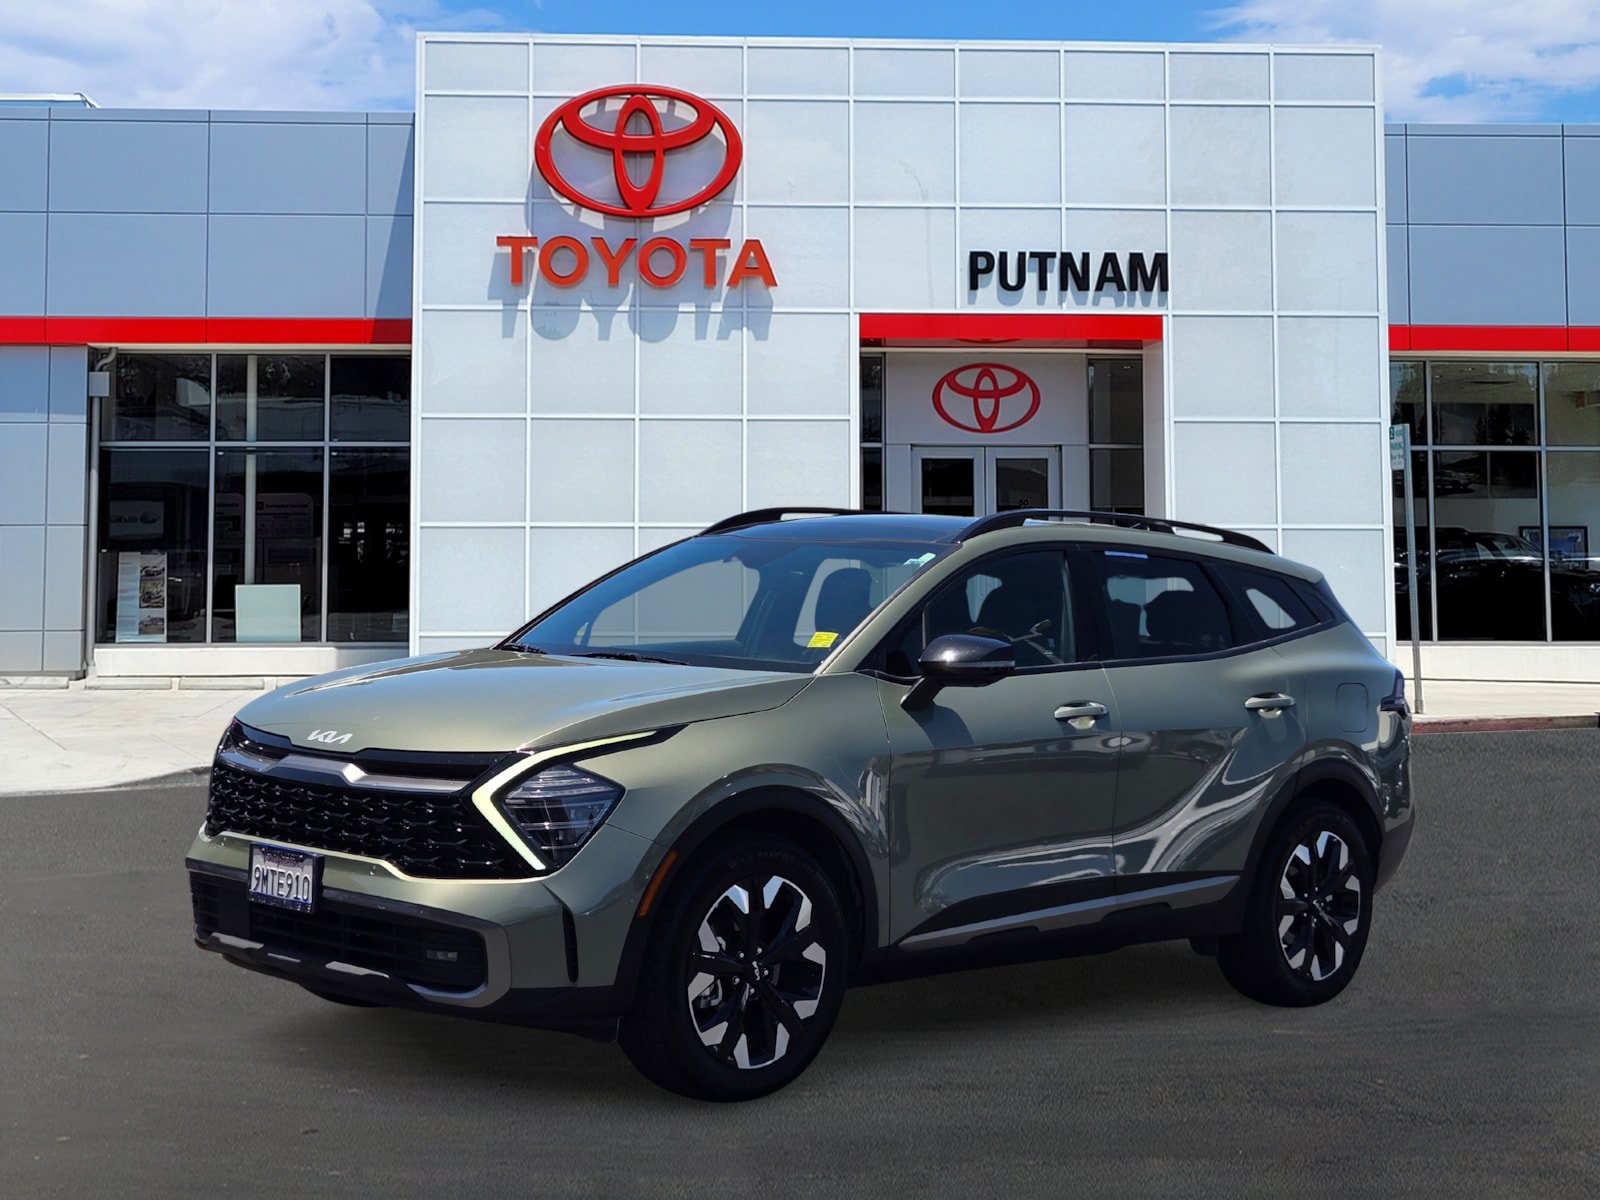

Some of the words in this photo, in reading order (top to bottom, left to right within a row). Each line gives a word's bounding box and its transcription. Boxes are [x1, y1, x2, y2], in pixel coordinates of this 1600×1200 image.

[496, 236, 778, 287] TOYOTA
[969, 251, 1169, 292] PUTNAM
[307, 729, 353, 744] KIA
[252, 865, 310, 902] 9MTE910
